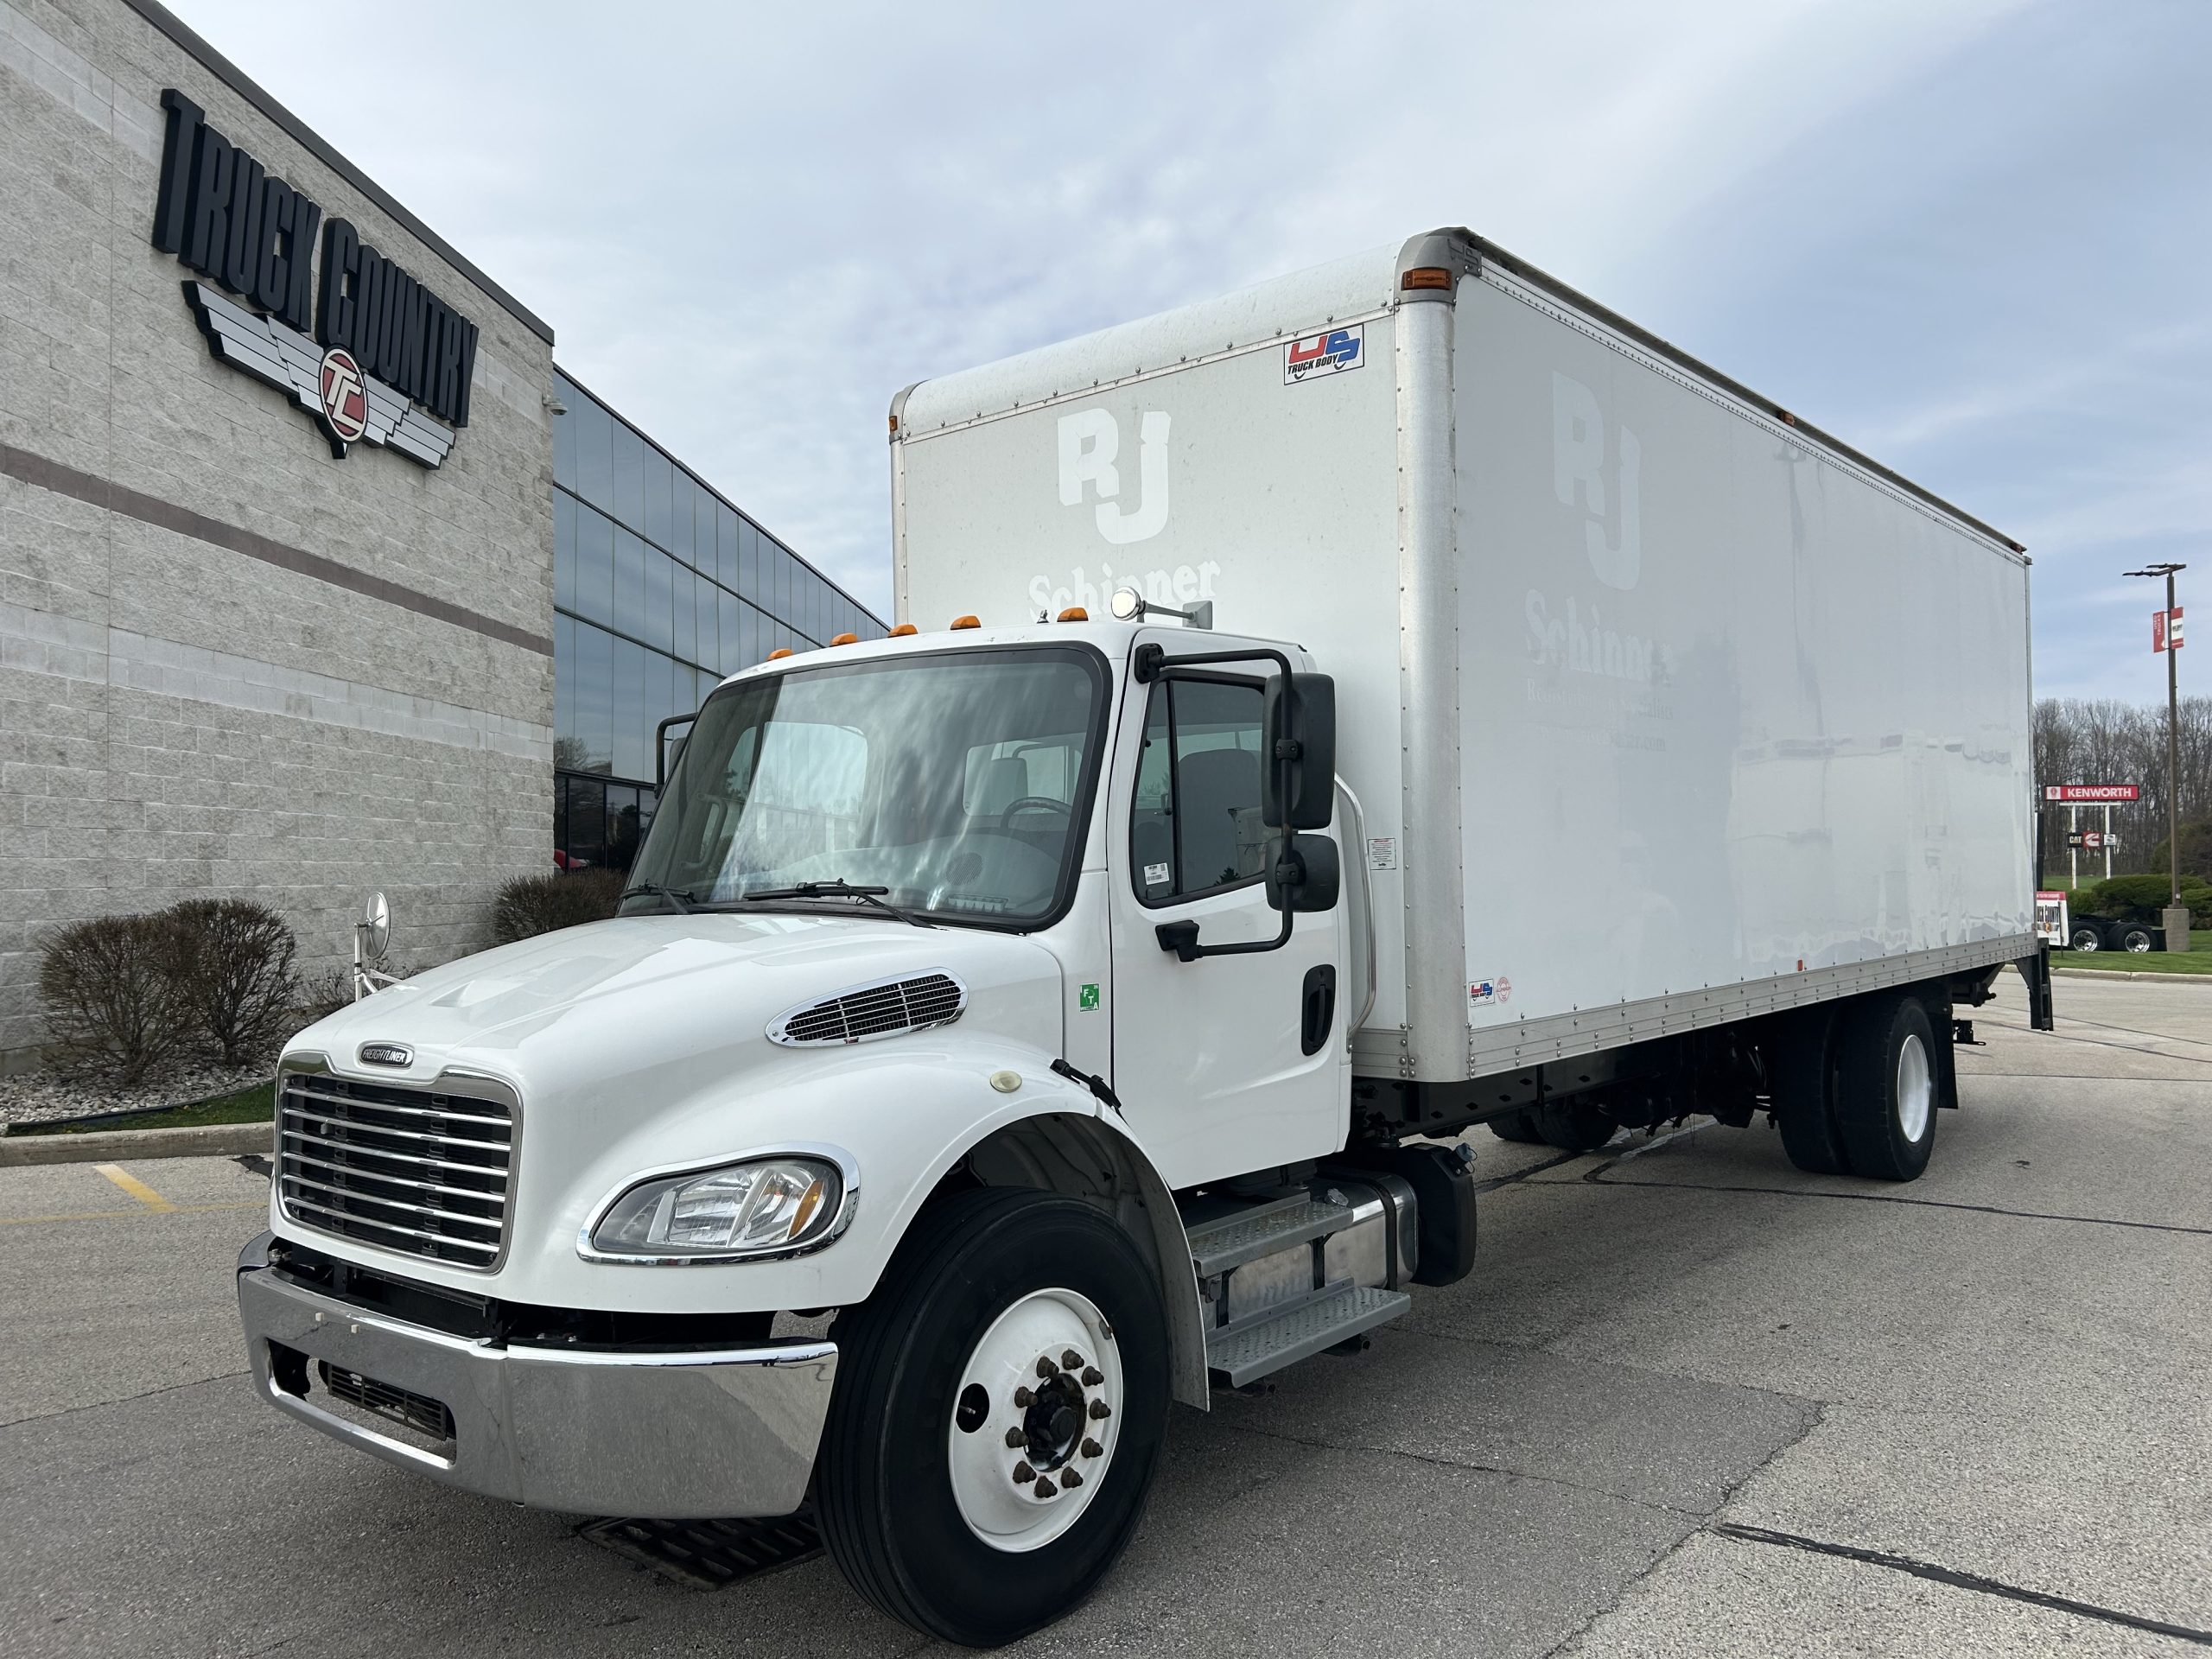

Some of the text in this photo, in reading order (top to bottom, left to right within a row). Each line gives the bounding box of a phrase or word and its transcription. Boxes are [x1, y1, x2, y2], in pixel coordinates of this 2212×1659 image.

[152, 88, 480, 428] TRUCK COUNTRY
[1288, 330, 1361, 365] US
[1287, 353, 1338, 375] TRUCK BODY
[1057, 408, 1172, 545] RJ
[1553, 370, 1643, 591] RJ
[2067, 787, 2132, 798] KENWORTH
[2069, 836, 2082, 844] CAT
[362, 1048, 406, 1063] FREIGHTLINER
